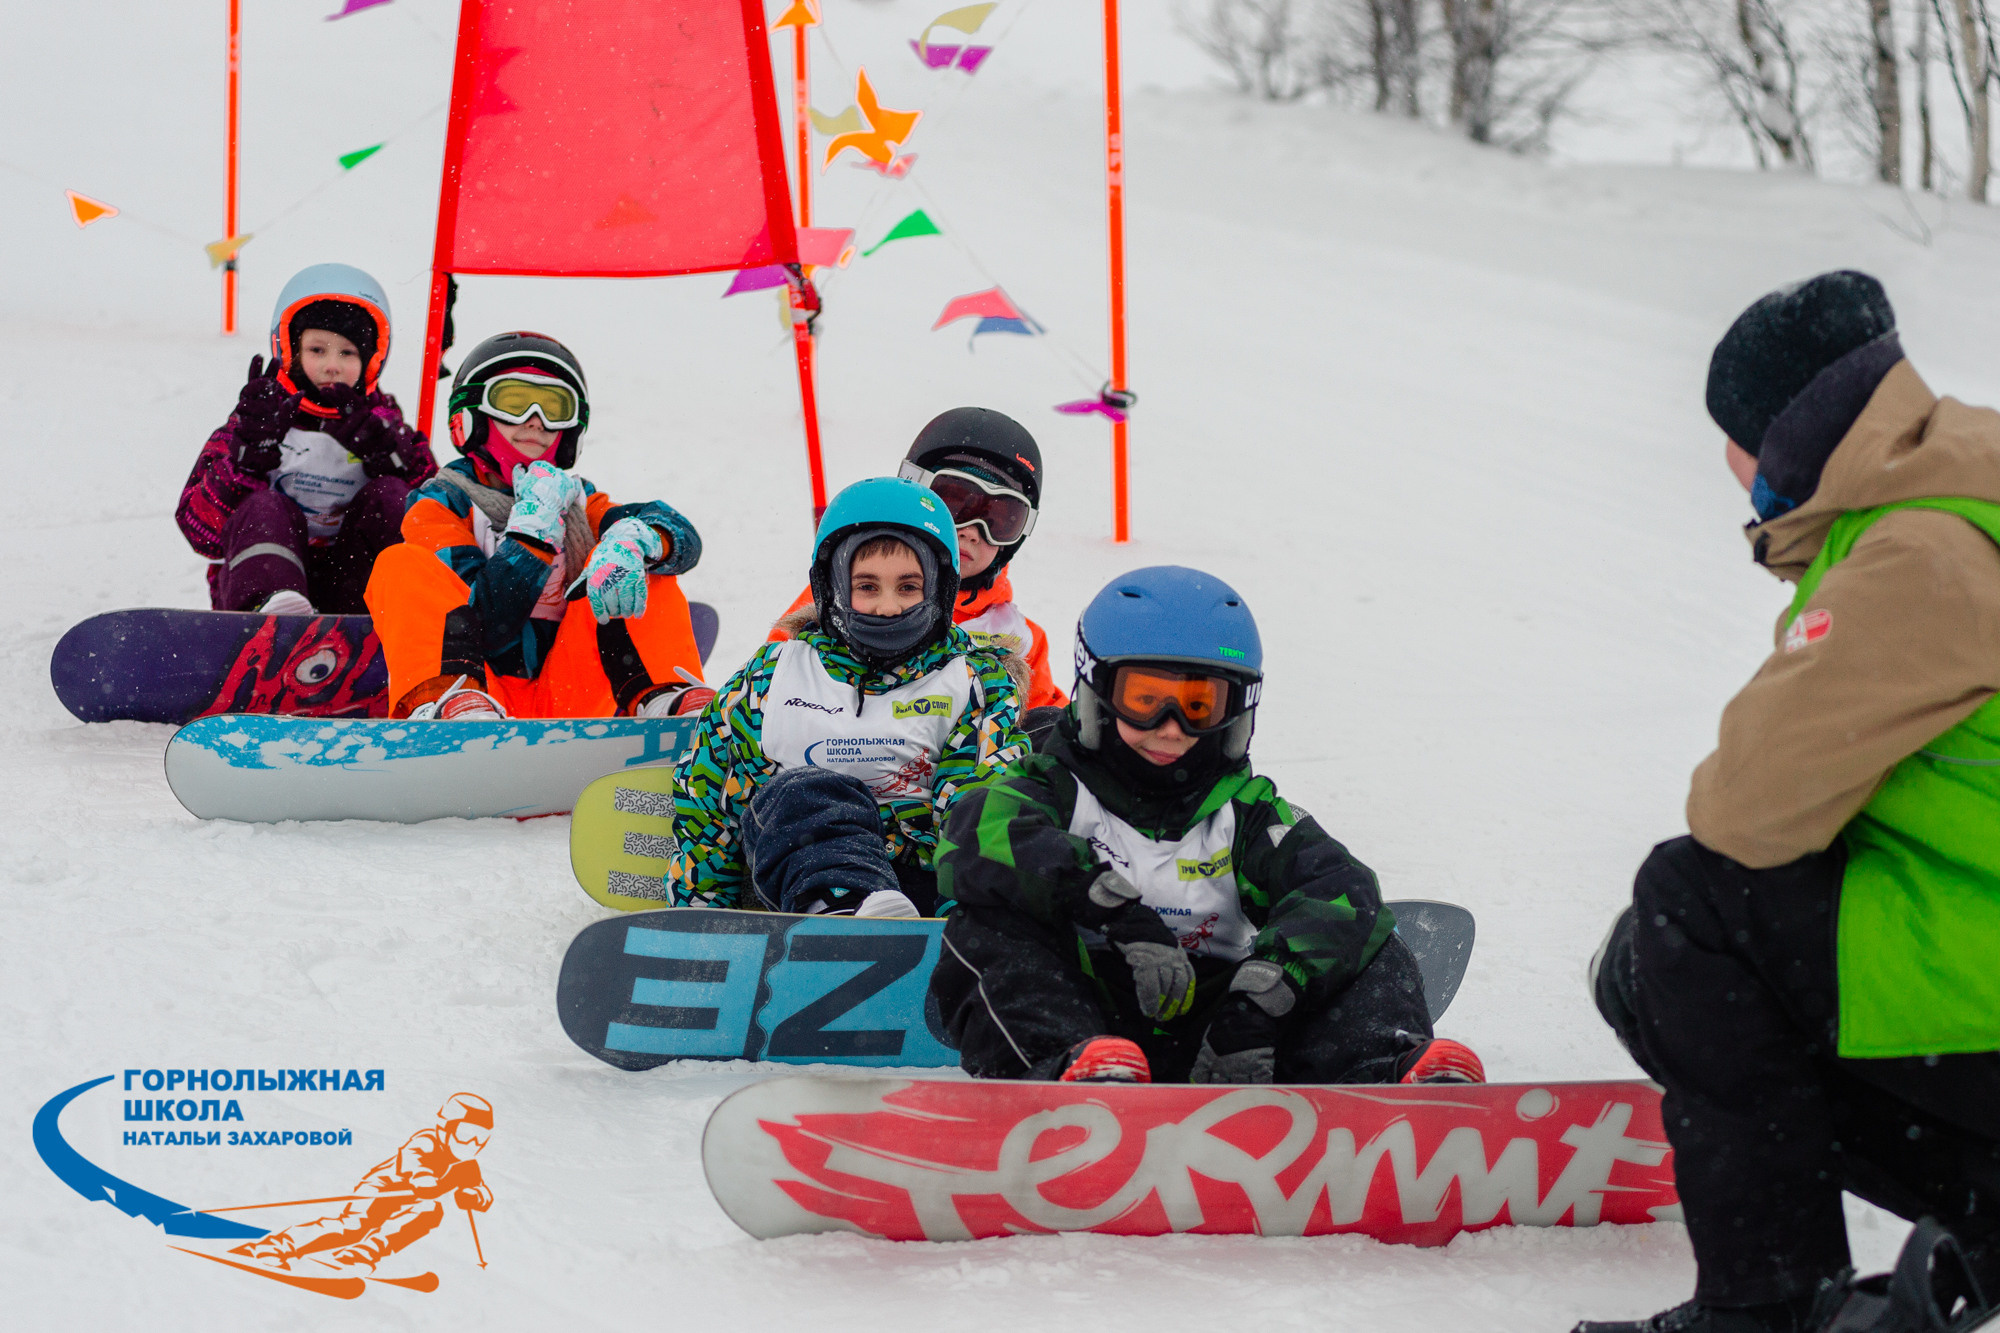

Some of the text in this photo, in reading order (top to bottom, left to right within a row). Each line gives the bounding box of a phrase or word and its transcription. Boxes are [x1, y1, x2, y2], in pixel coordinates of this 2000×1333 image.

[826, 738, 905, 746] ГОРНОЛЫЖНАЯ
[826, 747, 862, 756] ШКОЛА
[857, 755, 896, 763] ЗАХАРОВОЙ
